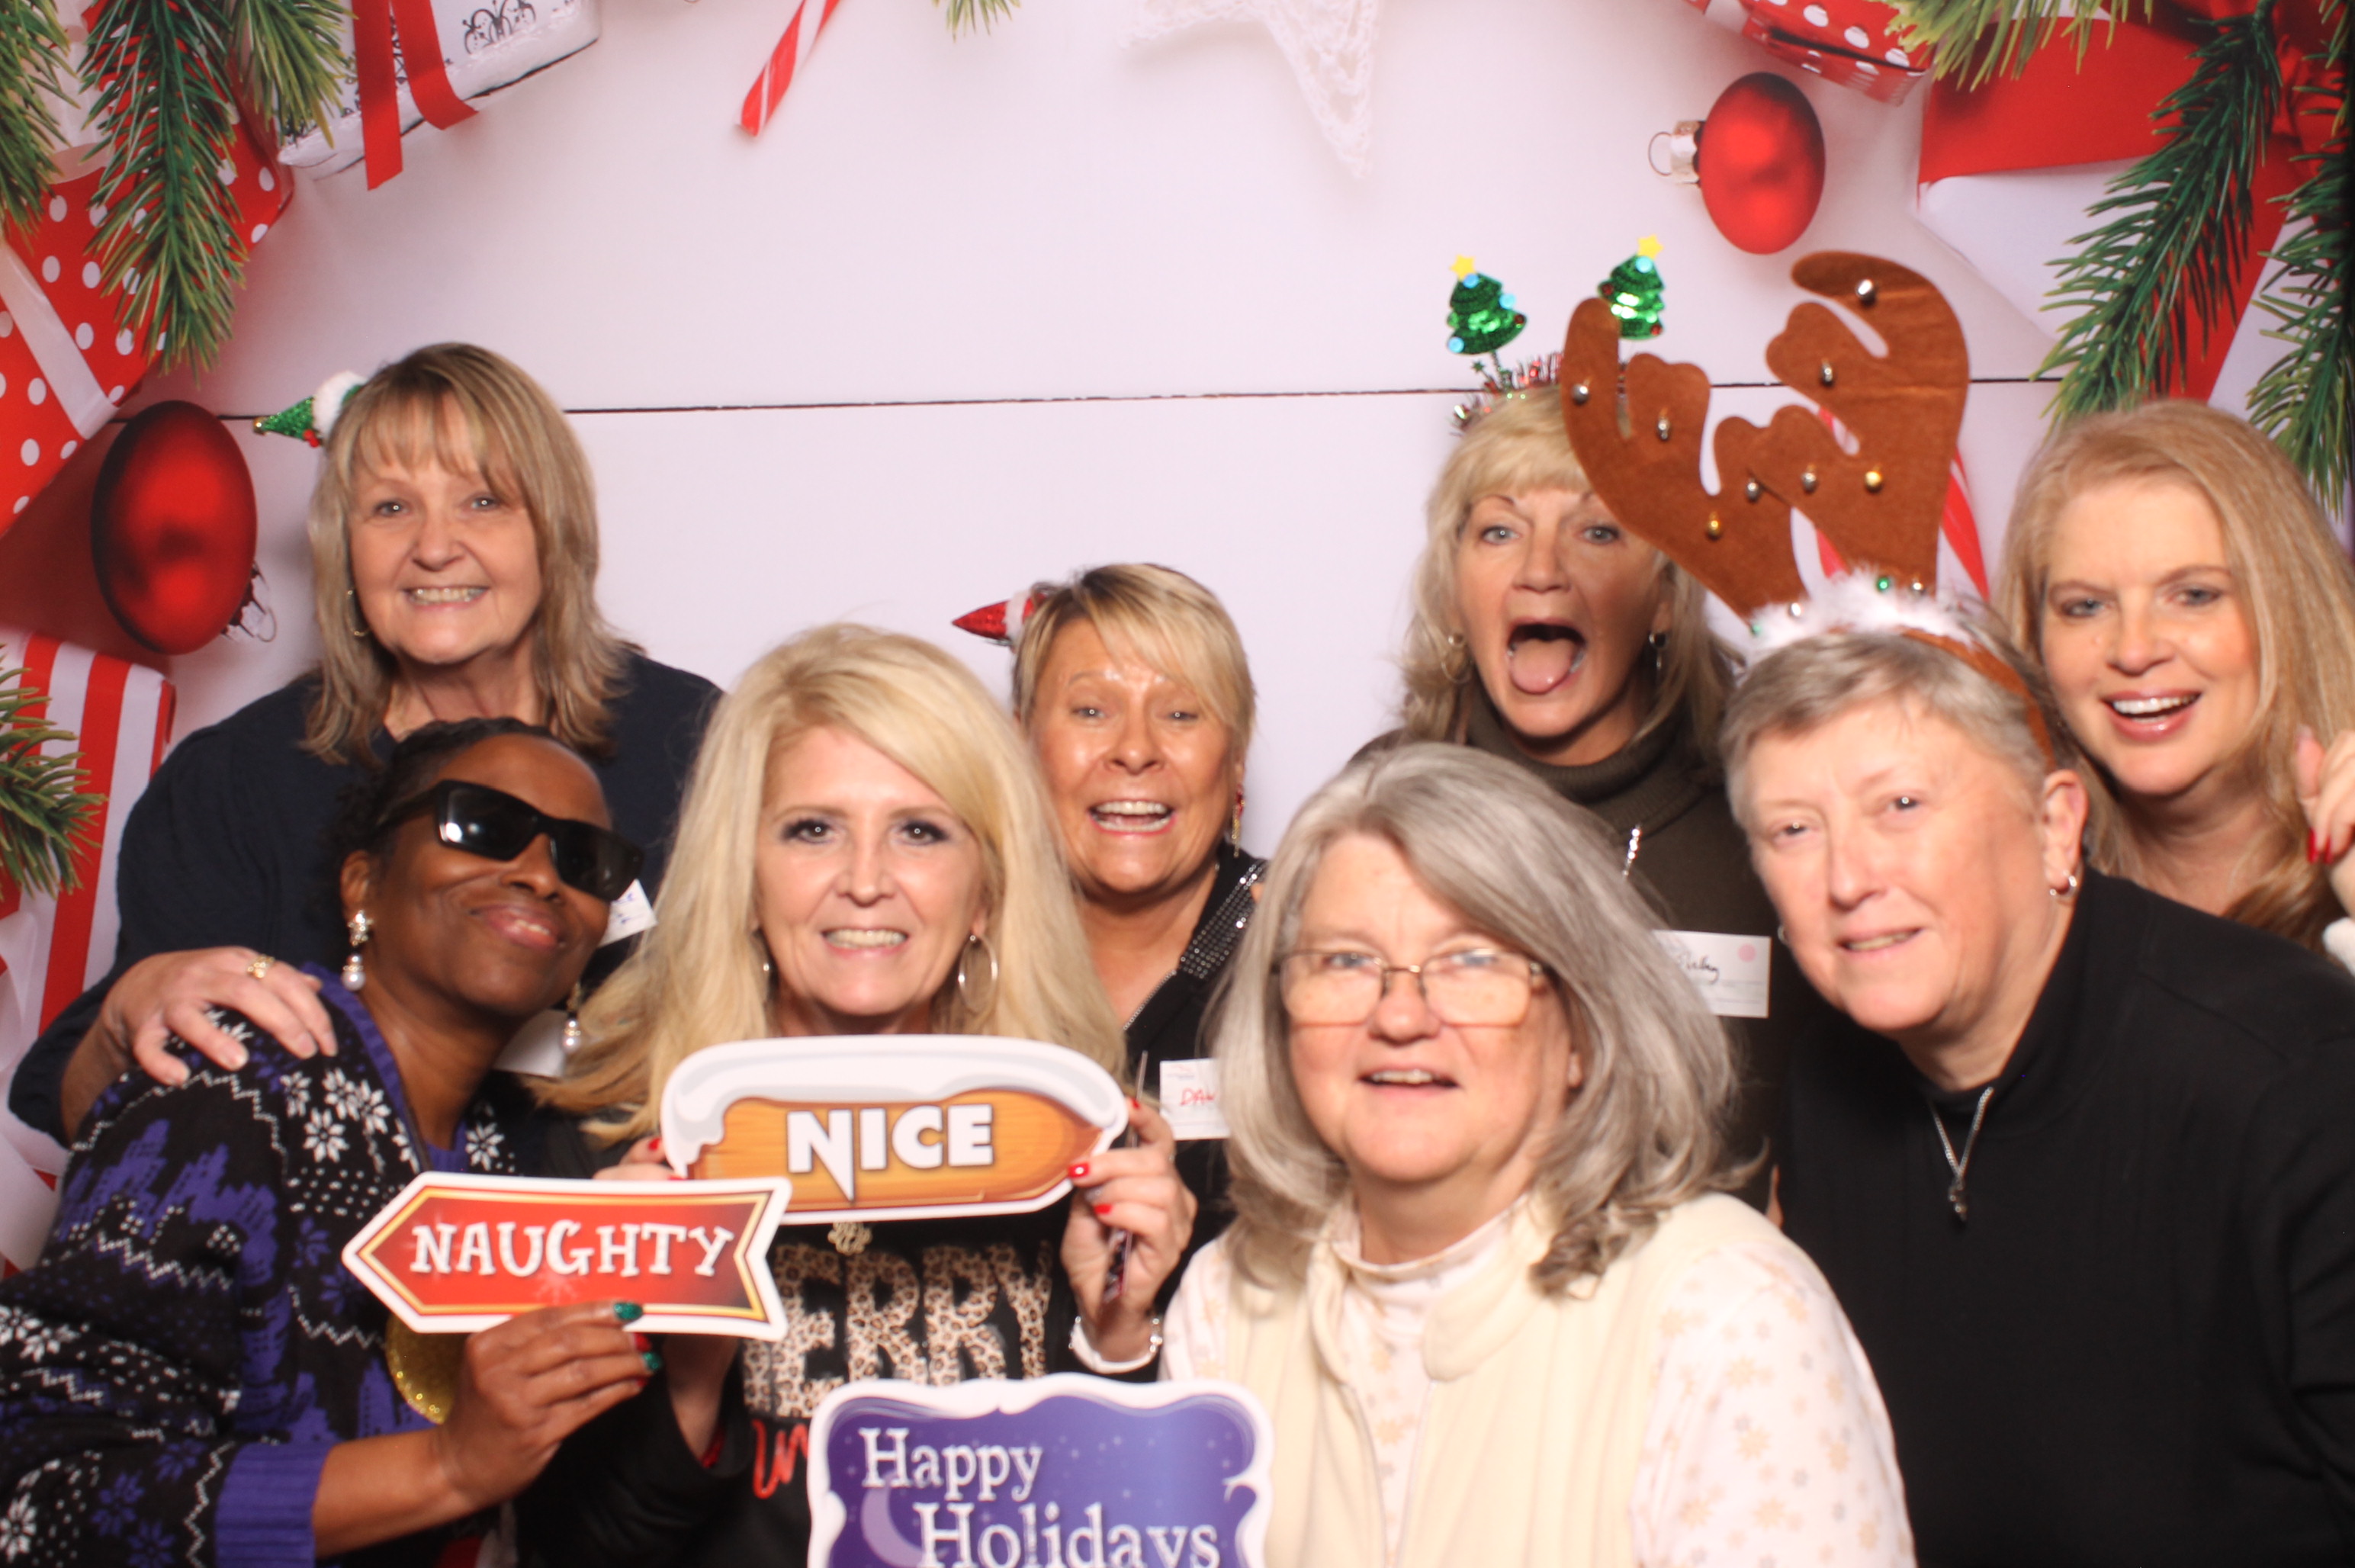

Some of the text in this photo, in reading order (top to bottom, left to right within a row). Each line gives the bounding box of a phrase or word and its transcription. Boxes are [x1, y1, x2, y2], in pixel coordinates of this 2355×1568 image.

[787, 1104, 994, 1203] NICE
[411, 1220, 734, 1278] NAUGHTY
[744, 1242, 1053, 1417] ERRY
[858, 1427, 1043, 1502] Happy
[912, 1502, 1221, 1568] Holidays
